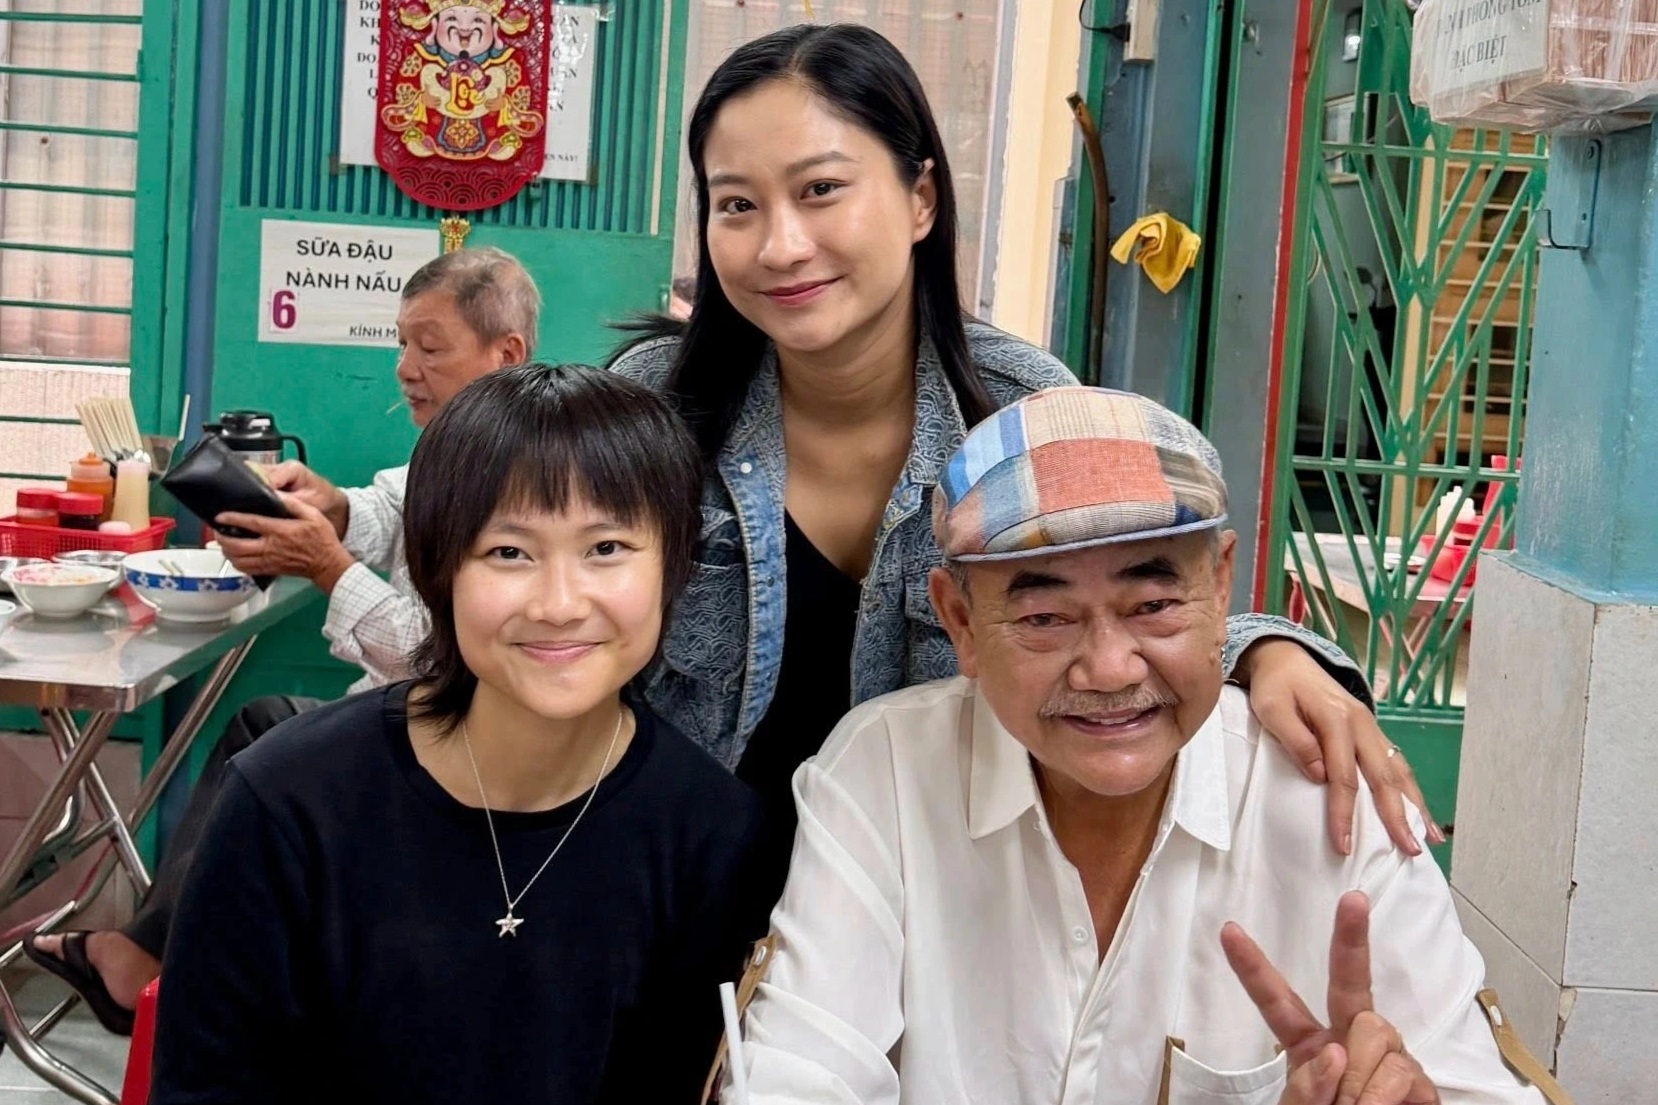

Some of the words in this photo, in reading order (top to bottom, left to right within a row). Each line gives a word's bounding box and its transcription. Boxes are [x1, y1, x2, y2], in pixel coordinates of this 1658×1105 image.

[296, 236, 341, 258] SỮA
[346, 239, 393, 263] ĐẬU
[286, 267, 349, 289] NÀNH
[356, 270, 402, 292] NẤU
[272, 290, 297, 330] 6
[349, 325, 383, 338] KÍNH
